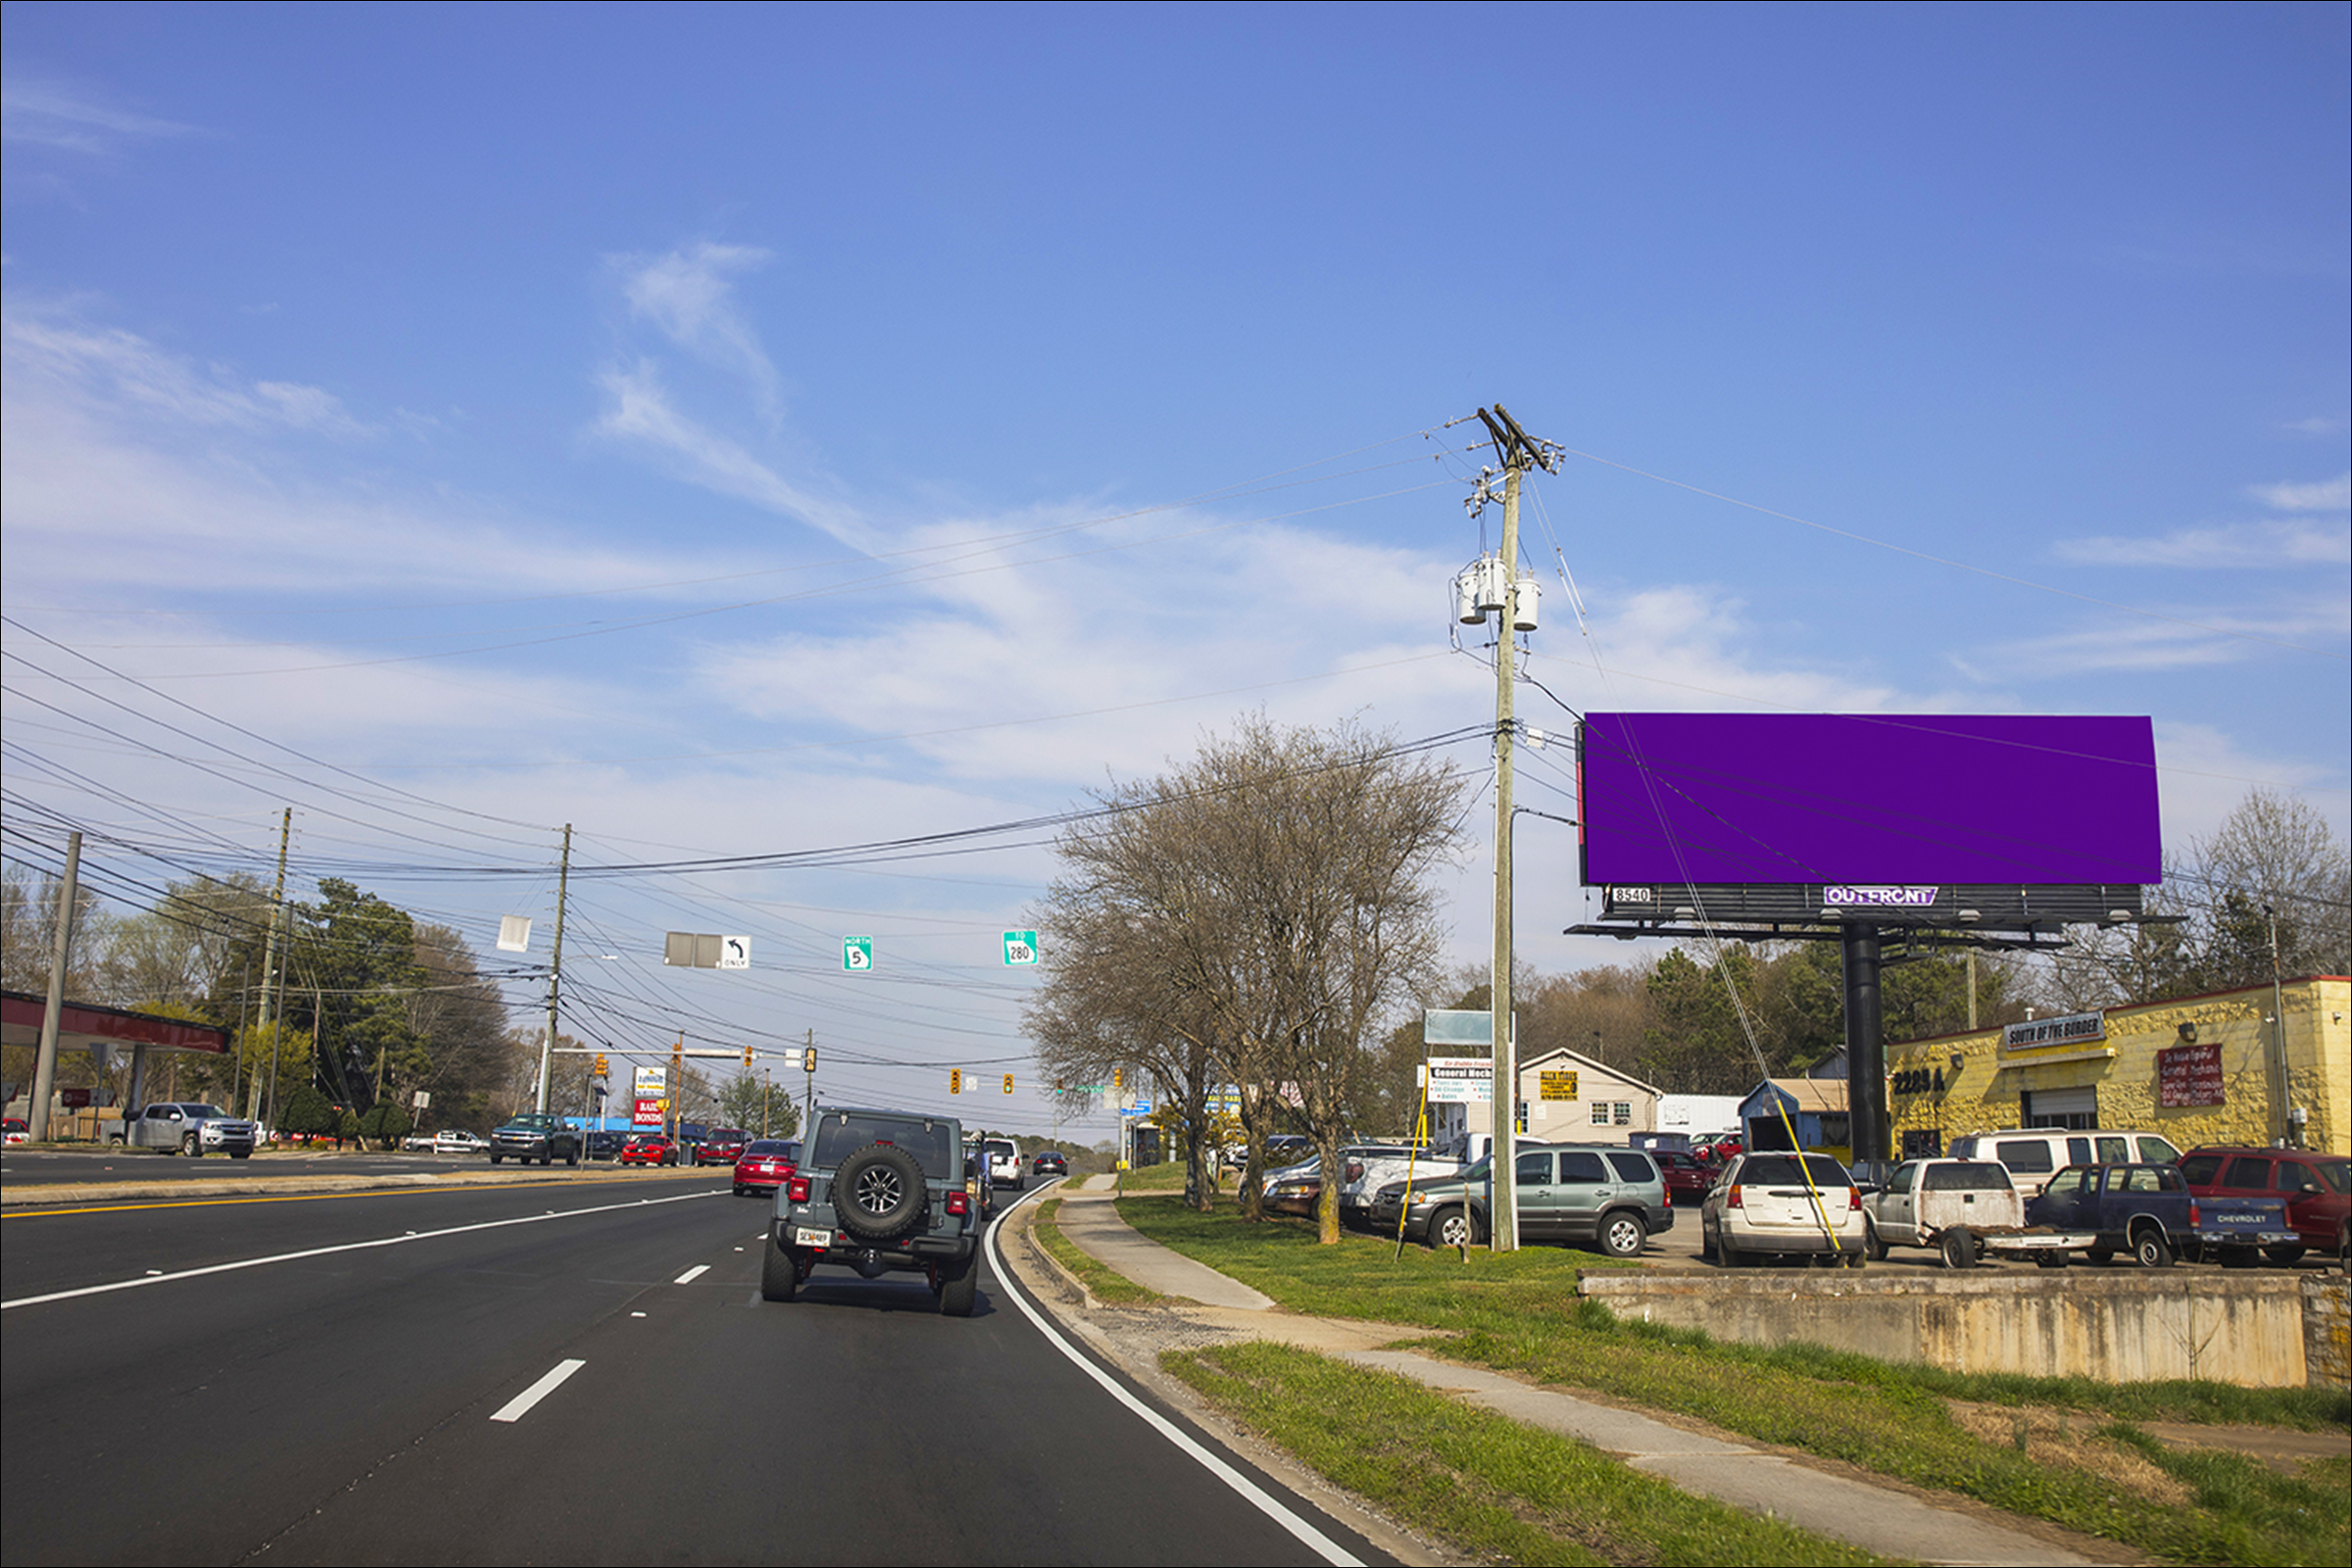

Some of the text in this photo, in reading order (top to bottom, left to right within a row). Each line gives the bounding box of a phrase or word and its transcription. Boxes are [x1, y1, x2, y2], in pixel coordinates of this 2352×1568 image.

[1615, 888, 1648, 901] 8540
[1828, 888, 1932, 903] OUTFRONT
[853, 951, 861, 964] 5
[1010, 946, 1029, 959] 280
[2009, 1018, 2098, 1045] SOUTH OF THE BORDER
[1434, 1068, 1467, 1077] General
[634, 1113, 662, 1123] BONDS
